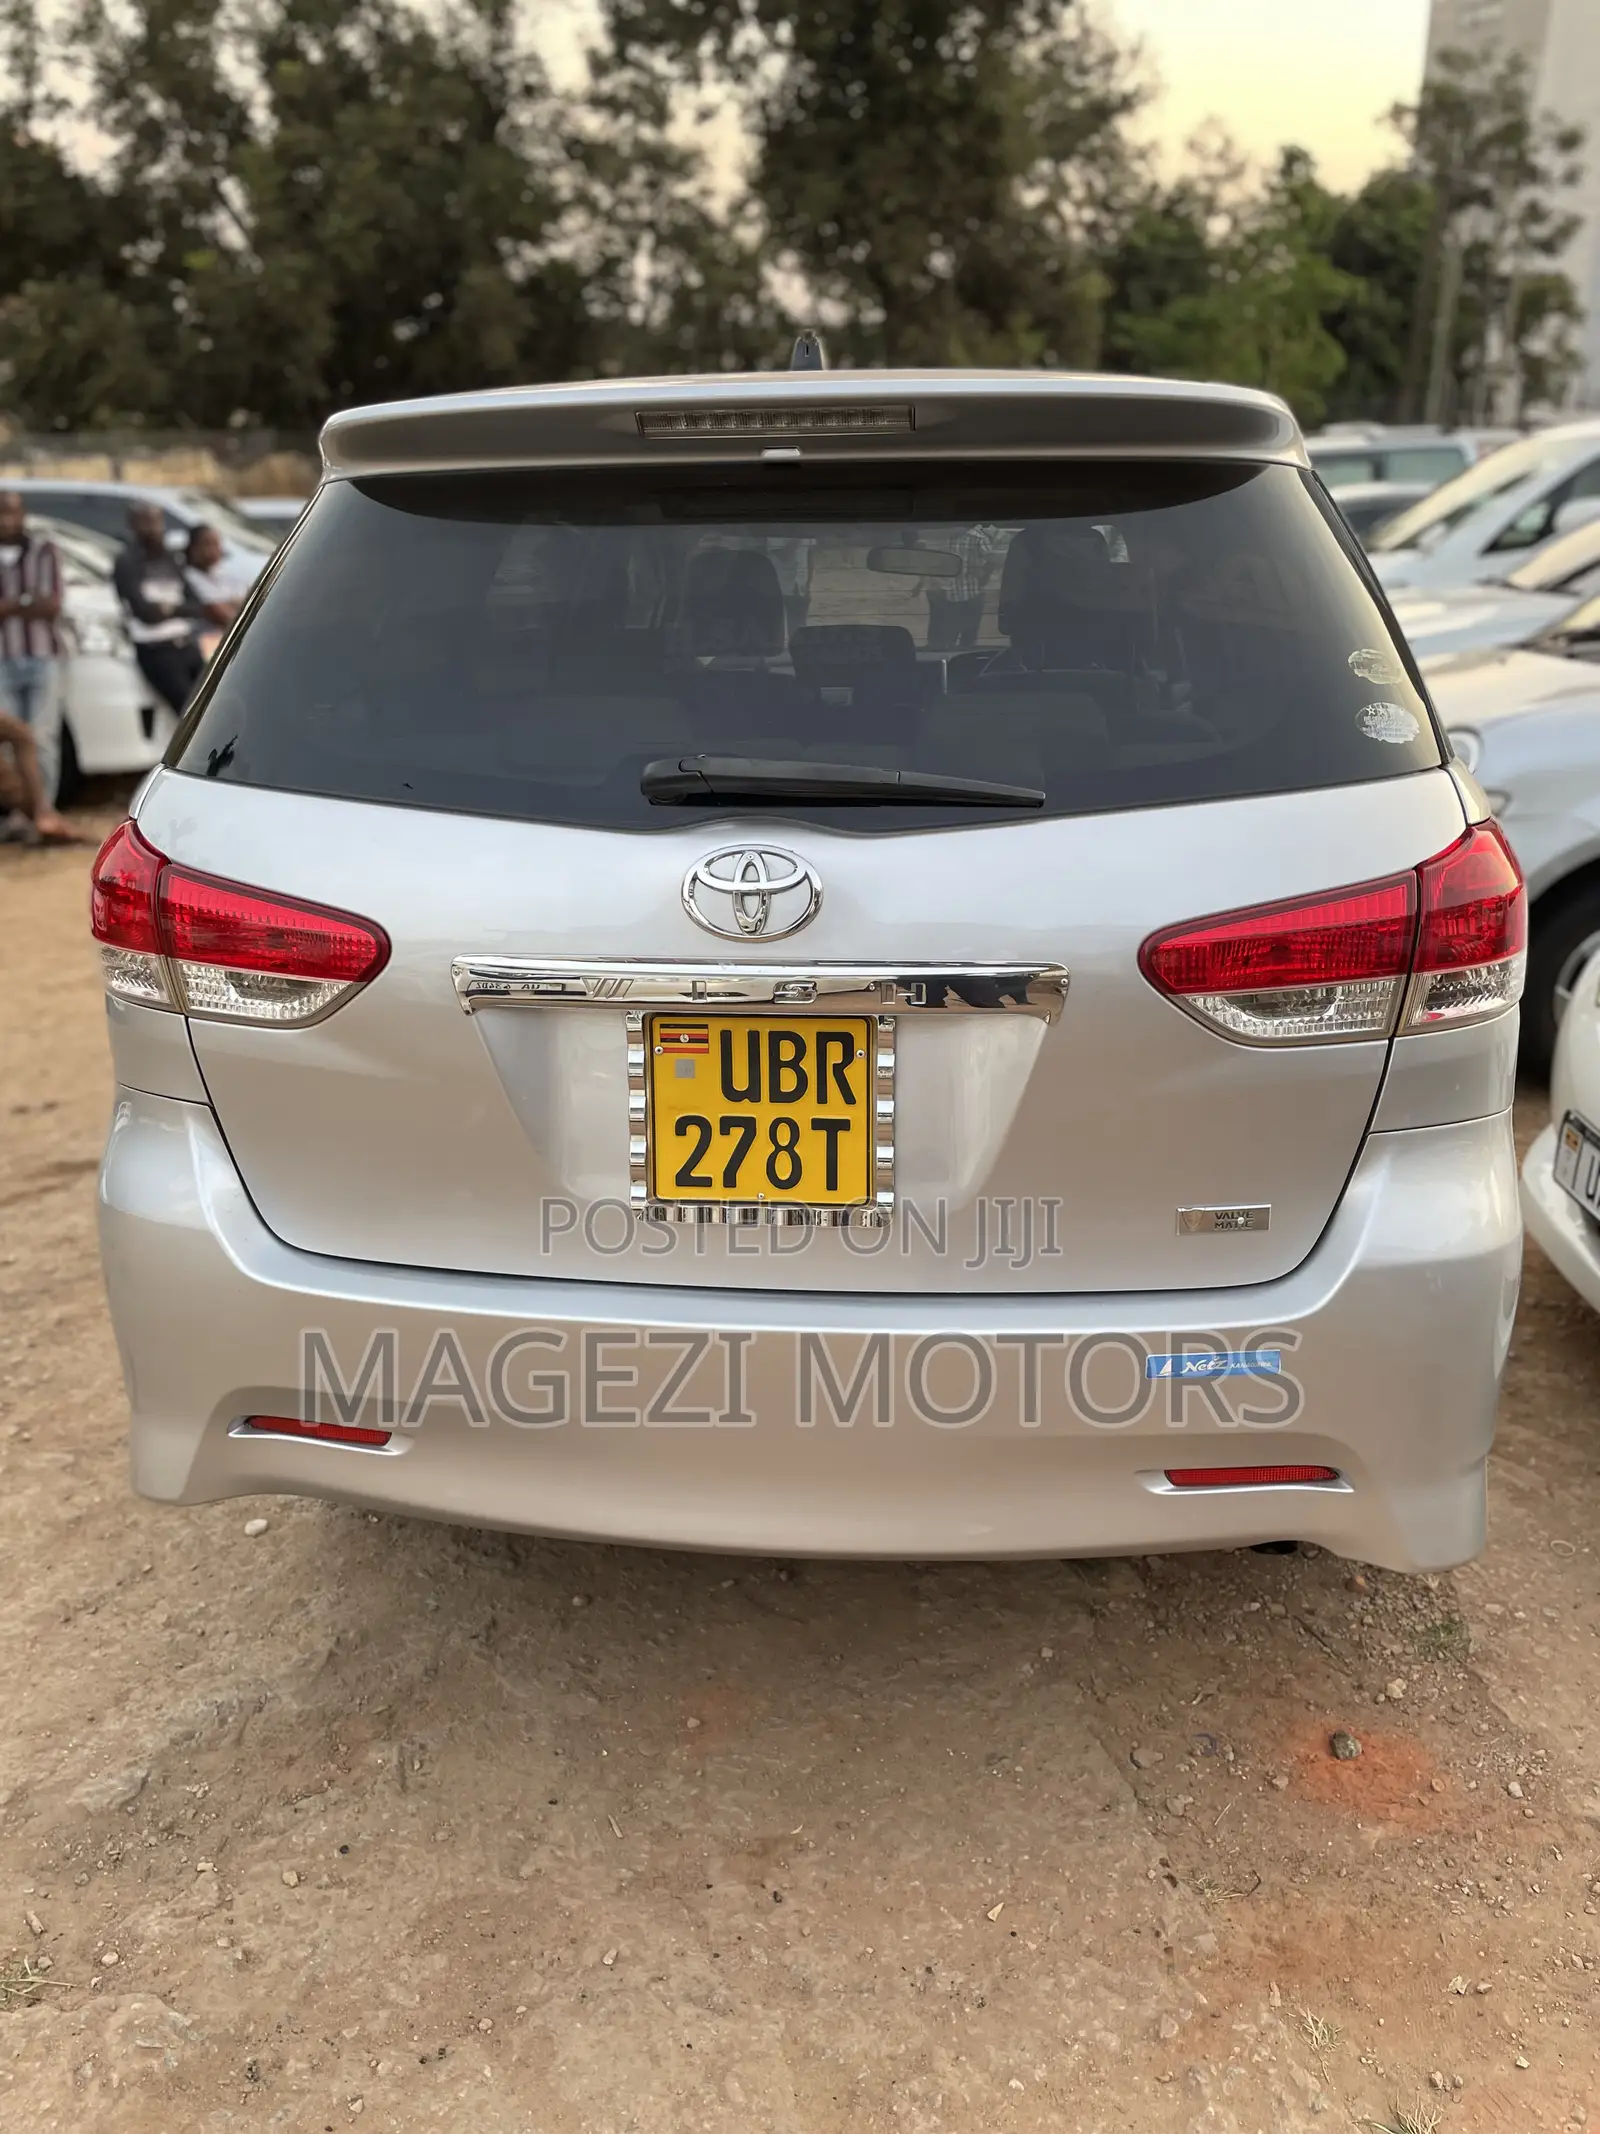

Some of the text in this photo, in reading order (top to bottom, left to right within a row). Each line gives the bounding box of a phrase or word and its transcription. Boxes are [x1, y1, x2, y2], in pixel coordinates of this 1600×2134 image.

[580, 977, 927, 1005] WISH
[720, 1030, 857, 1104] UBR
[675, 1115, 851, 1191] 278T
[1214, 1210, 1254, 1220] VALVE
